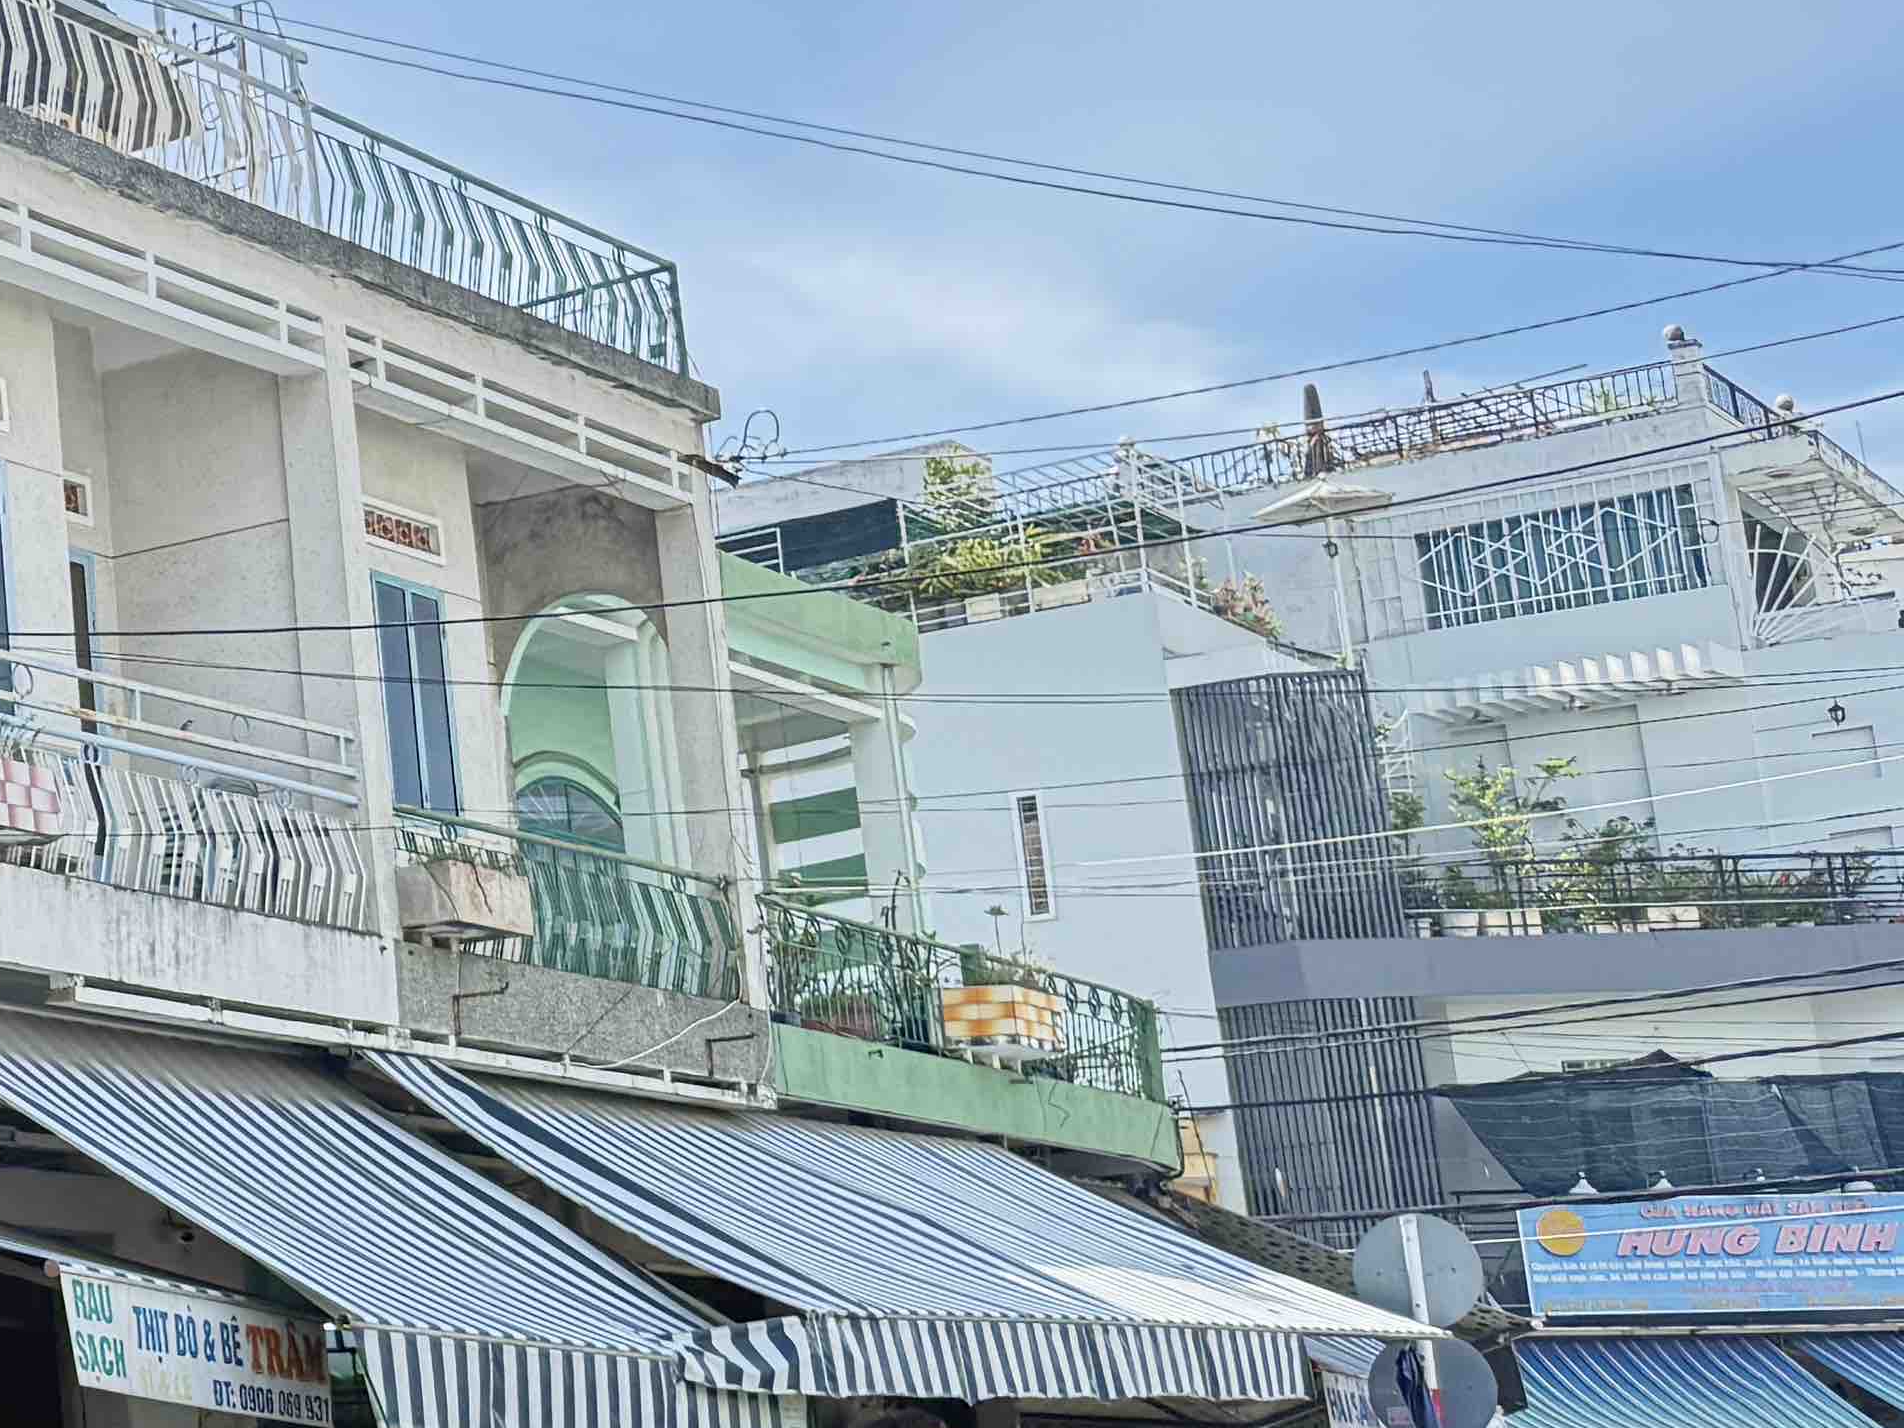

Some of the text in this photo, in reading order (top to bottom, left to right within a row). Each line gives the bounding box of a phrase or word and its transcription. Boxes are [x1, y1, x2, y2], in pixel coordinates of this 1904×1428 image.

[72, 1277, 114, 1325] RAU
[75, 1330, 128, 1384] SẠCH
[132, 1306, 170, 1363] THỊT
[203, 1319, 217, 1363] &
